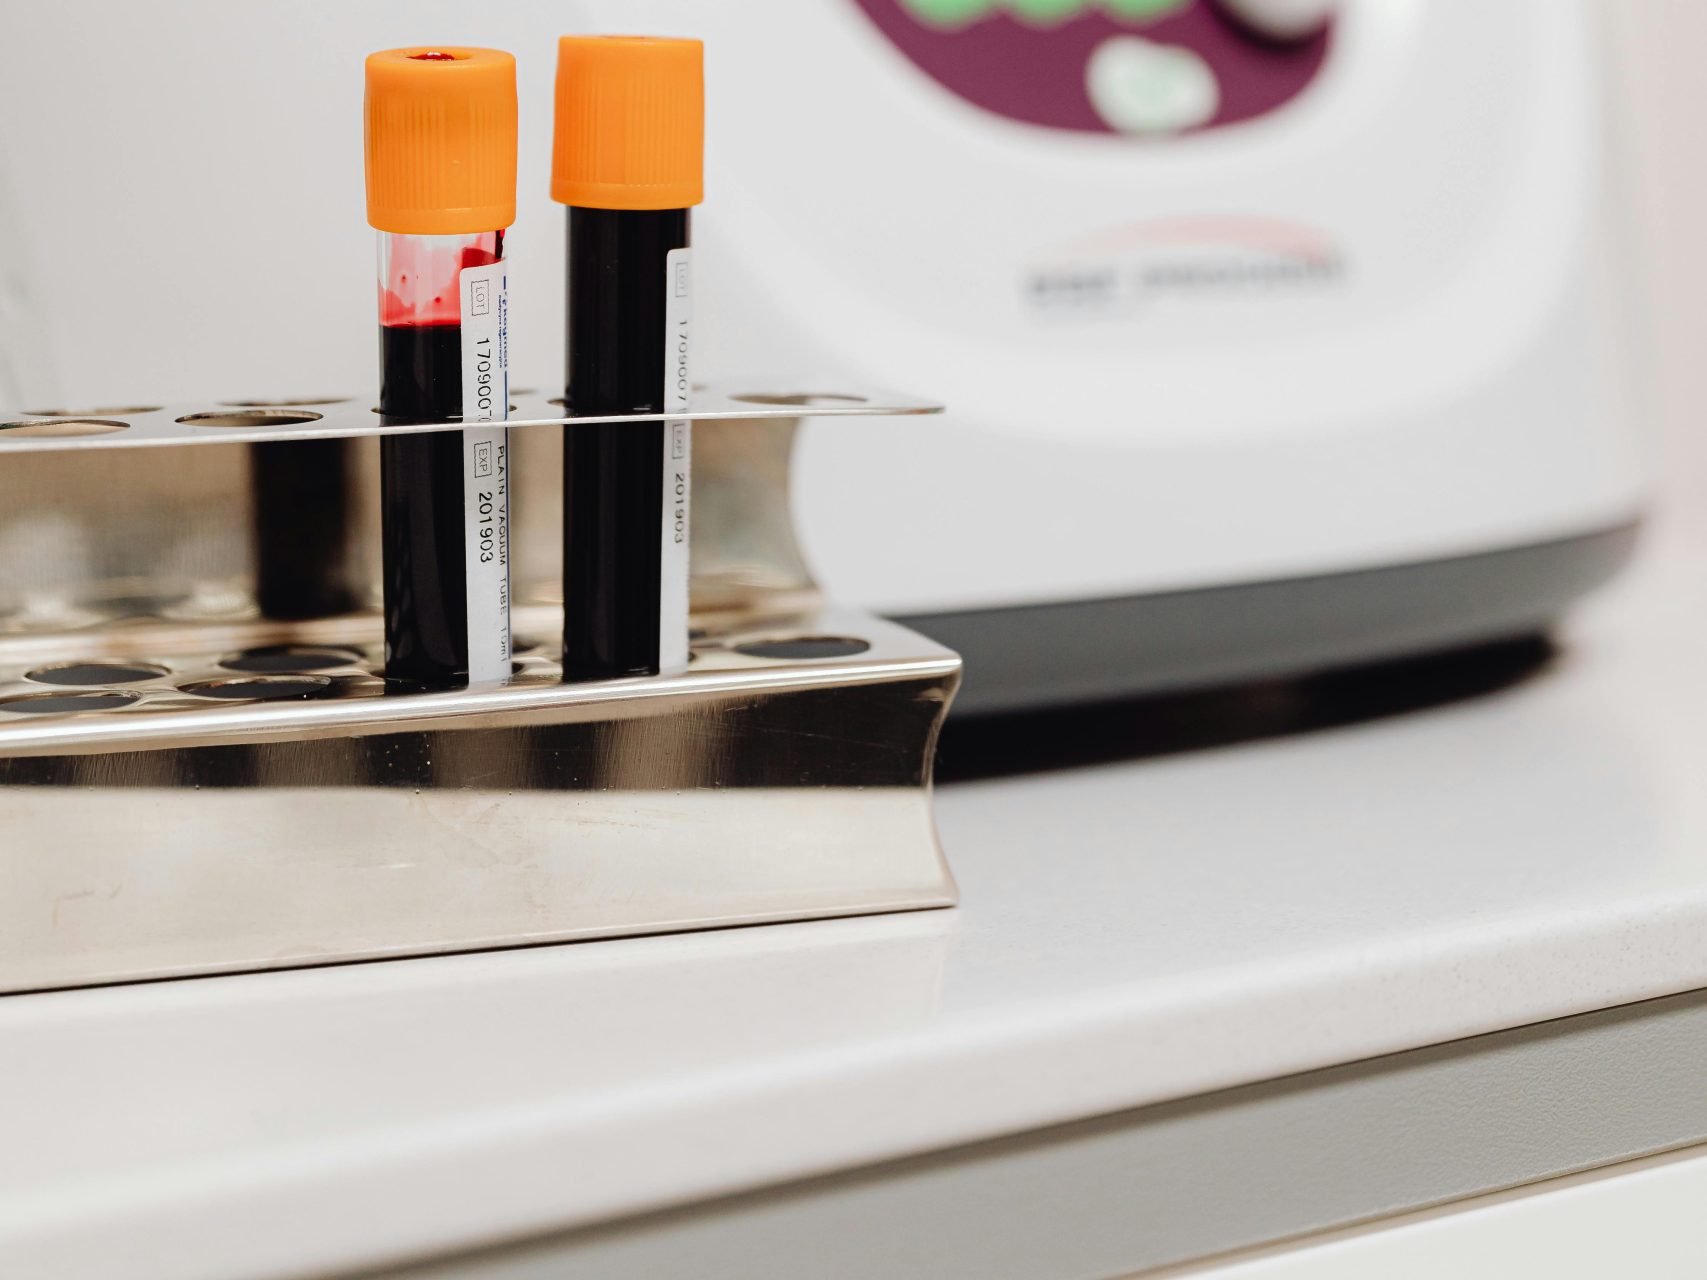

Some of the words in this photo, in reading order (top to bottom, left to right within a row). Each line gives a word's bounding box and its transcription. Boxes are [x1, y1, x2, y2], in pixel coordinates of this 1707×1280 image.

[475, 286, 485, 309] LOT
[677, 319, 688, 401] 1709007
[478, 448, 488, 472] EXP
[478, 491, 493, 563] 201903
[674, 473, 685, 544] 201903
